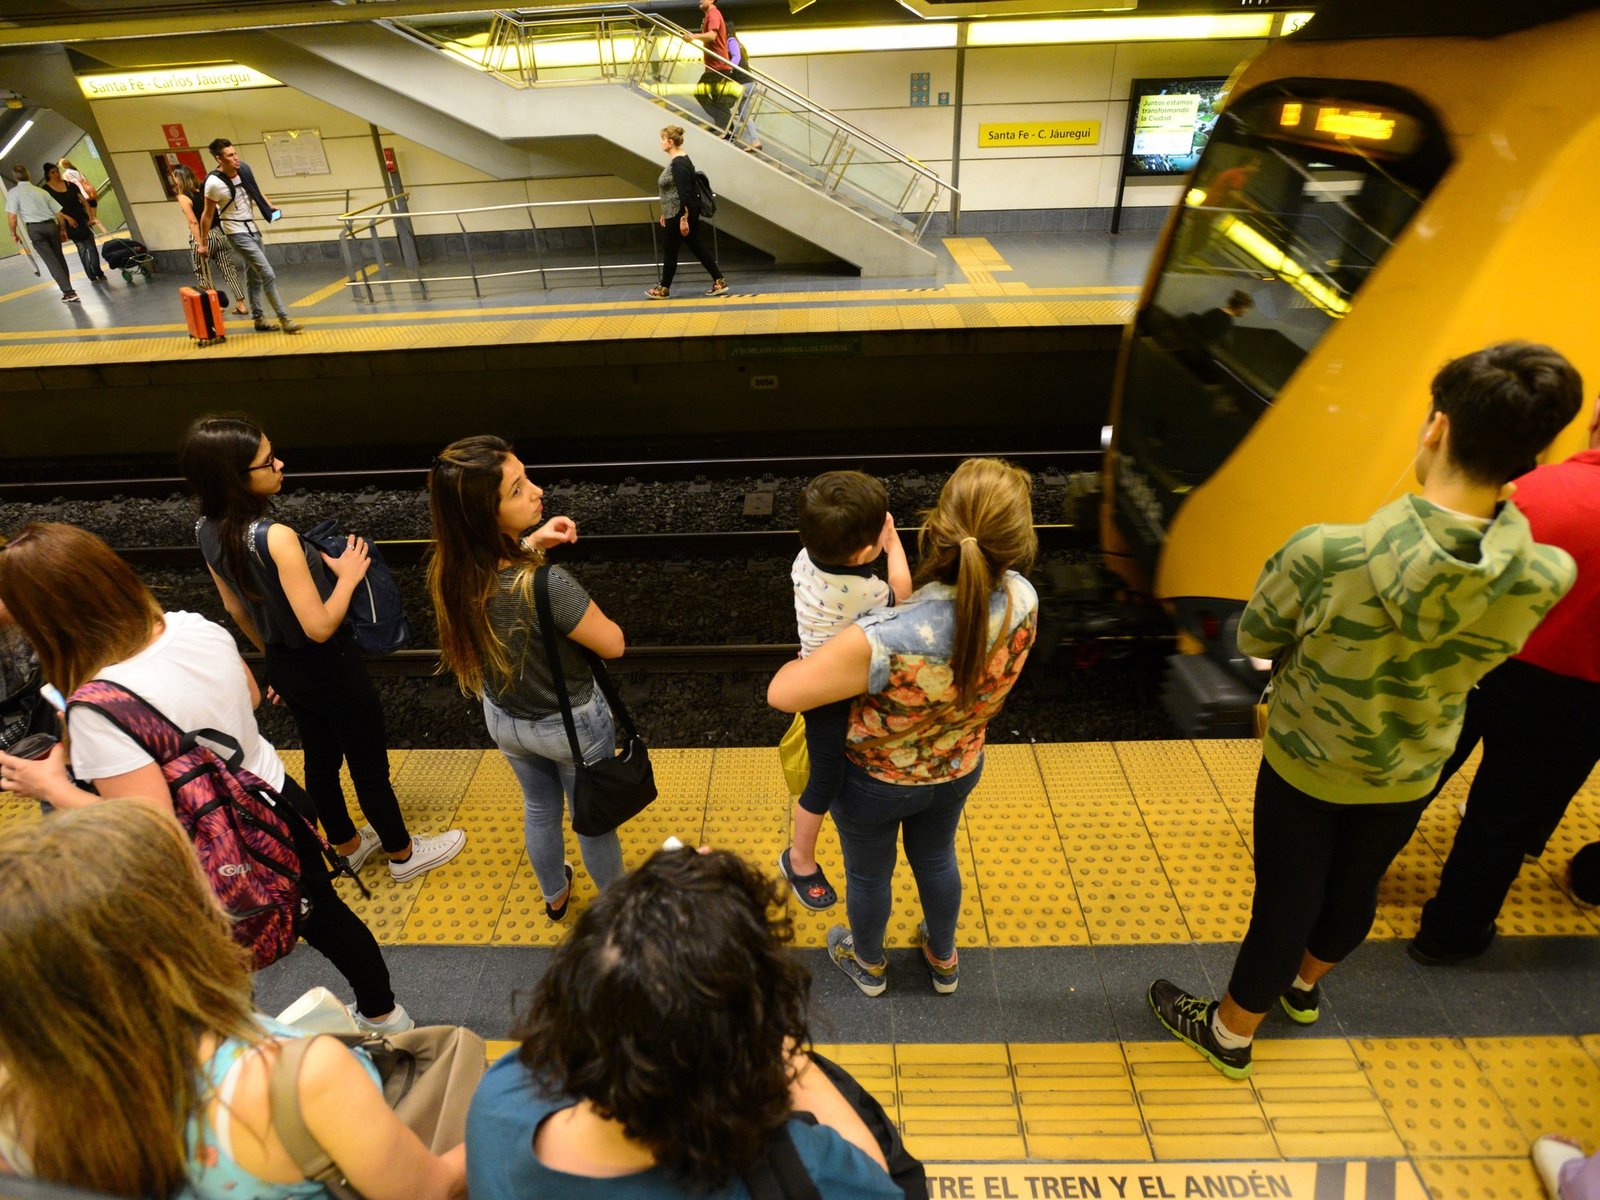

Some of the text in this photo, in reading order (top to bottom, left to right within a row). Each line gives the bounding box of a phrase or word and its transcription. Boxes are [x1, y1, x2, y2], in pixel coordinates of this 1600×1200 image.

[89, 80, 127, 94] Santa
[128, 78, 145, 91] Fe
[152, 74, 193, 89] Carlos
[988, 130, 1016, 140] Santa
[1018, 130, 1030, 140] Fe
[1037, 129, 1047, 139] C.
[1049, 127, 1091, 140] Jáuregui
[983, 1176, 1019, 1199] EL
[1024, 1176, 1102, 1199] TREN
[1107, 1176, 1128, 1199] Y
[1138, 1176, 1176, 1199] EL
[1185, 1169, 1293, 1199] ANDÉN
